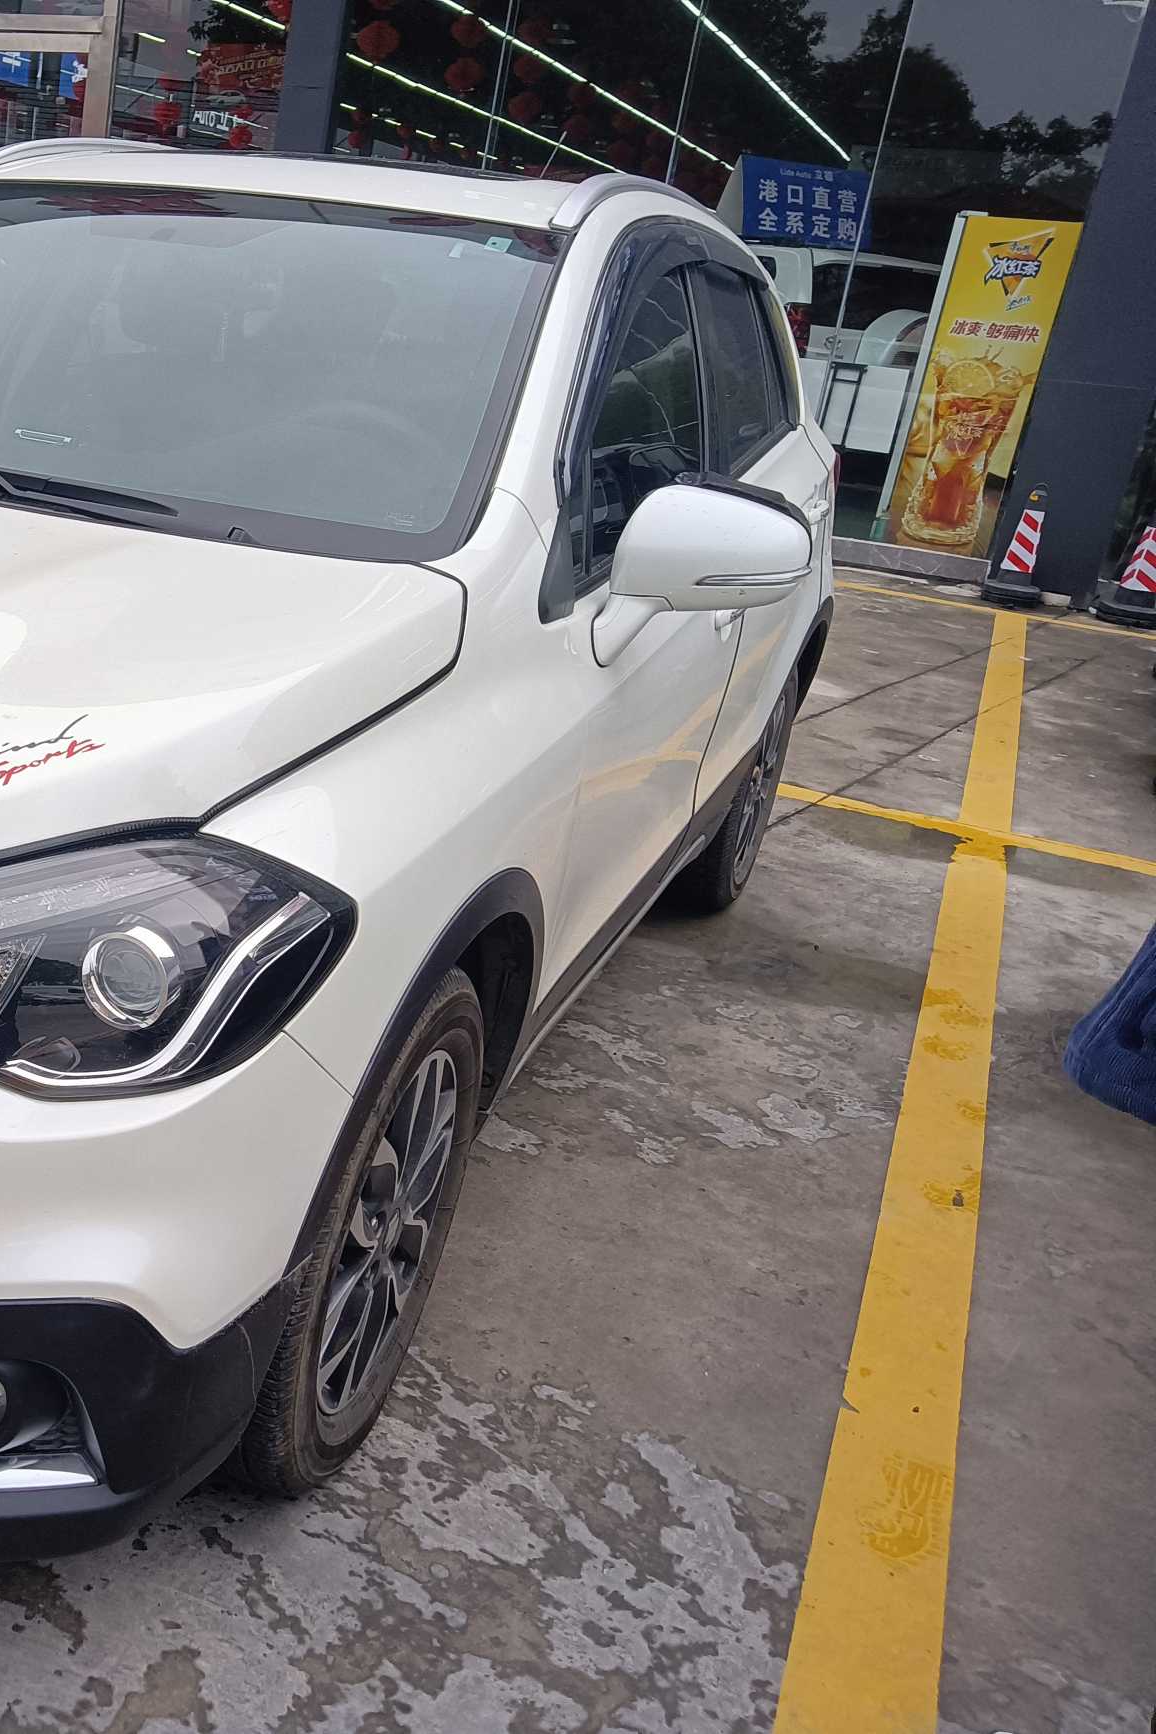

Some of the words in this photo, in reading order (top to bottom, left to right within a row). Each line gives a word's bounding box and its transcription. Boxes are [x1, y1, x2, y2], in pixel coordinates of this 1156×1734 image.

[758, 178, 858, 214] 港口直营
[758, 207, 857, 241] 全系定购
[986, 256, 1042, 280] 冰红茶
[949, 319, 1040, 343] 冰爽·够痛快
